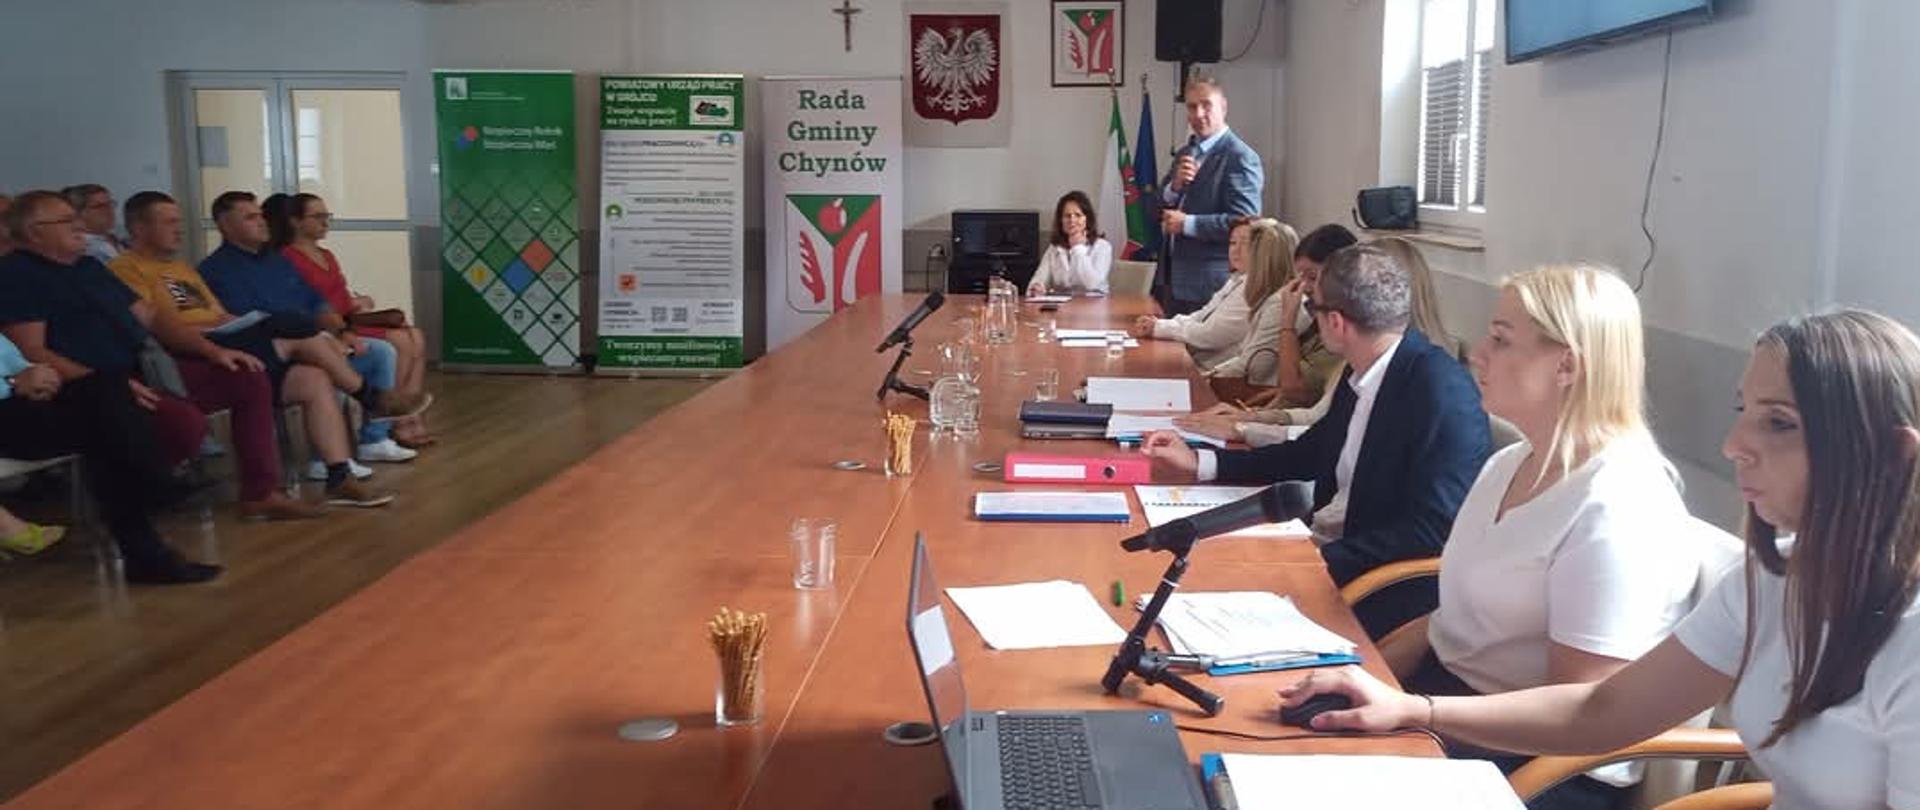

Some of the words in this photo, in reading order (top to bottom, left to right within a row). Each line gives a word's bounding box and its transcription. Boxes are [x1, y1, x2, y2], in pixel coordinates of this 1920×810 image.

[797, 89, 866, 110] Rada
[787, 120, 878, 146] Gminy
[779, 151, 887, 177] Chynów
